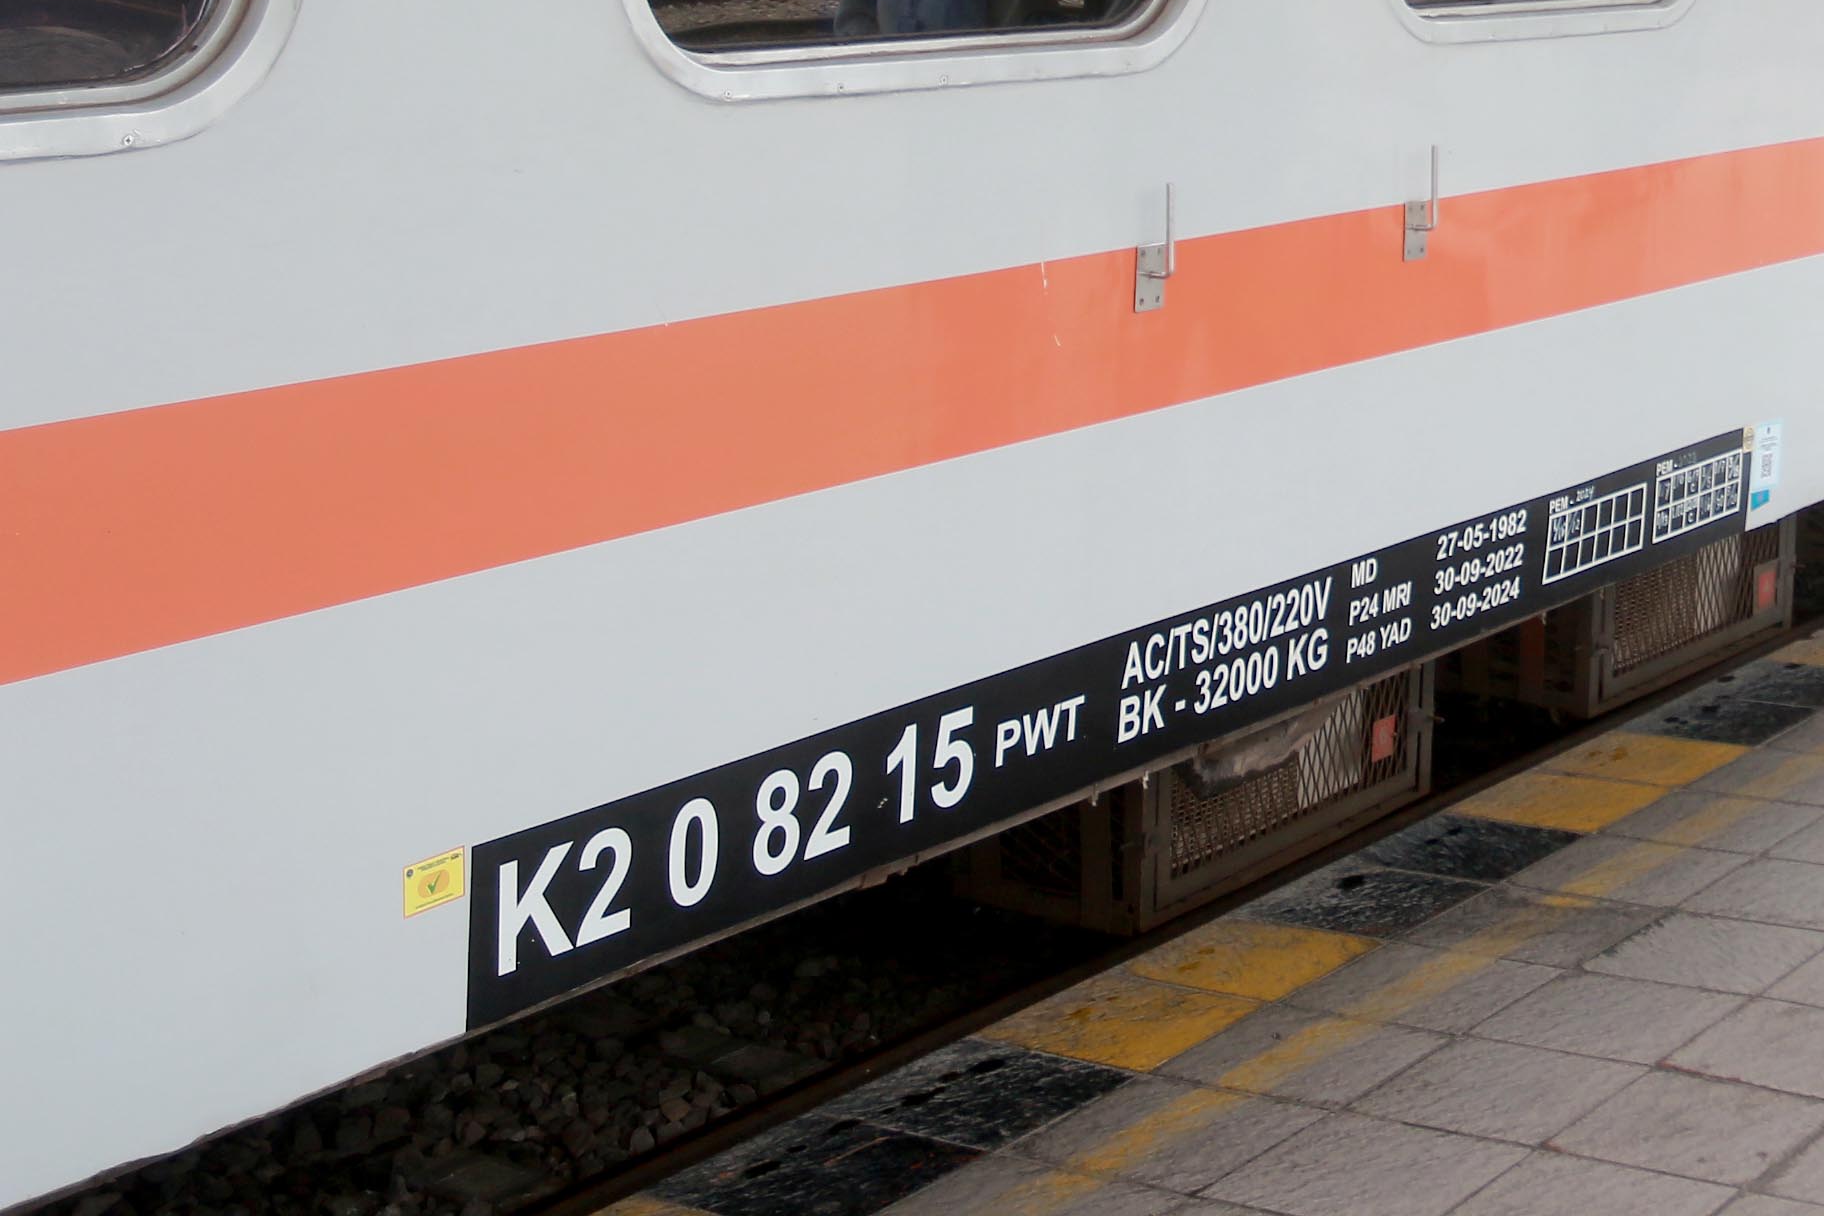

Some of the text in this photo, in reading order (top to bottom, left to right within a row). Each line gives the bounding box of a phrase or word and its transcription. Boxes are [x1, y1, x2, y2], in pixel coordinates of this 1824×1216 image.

[1549, 495, 1568, 514] PEM
[1656, 459, 1673, 477] PEM
[1348, 543, 1524, 626] P24 MRI 30-09-2022
[1351, 558, 1377, 589] MD
[1436, 509, 1527, 561] 27-05-1982
[1121, 576, 1333, 690] AC/TS/380/220V
[1346, 576, 1521, 664] P48 YAD 30-09-2024
[1117, 683, 1167, 744] BK
[1193, 645, 1279, 714] 32000
[1286, 627, 1329, 681] KG
[497, 695, 1086, 978] K2 0 82 15 PWT
